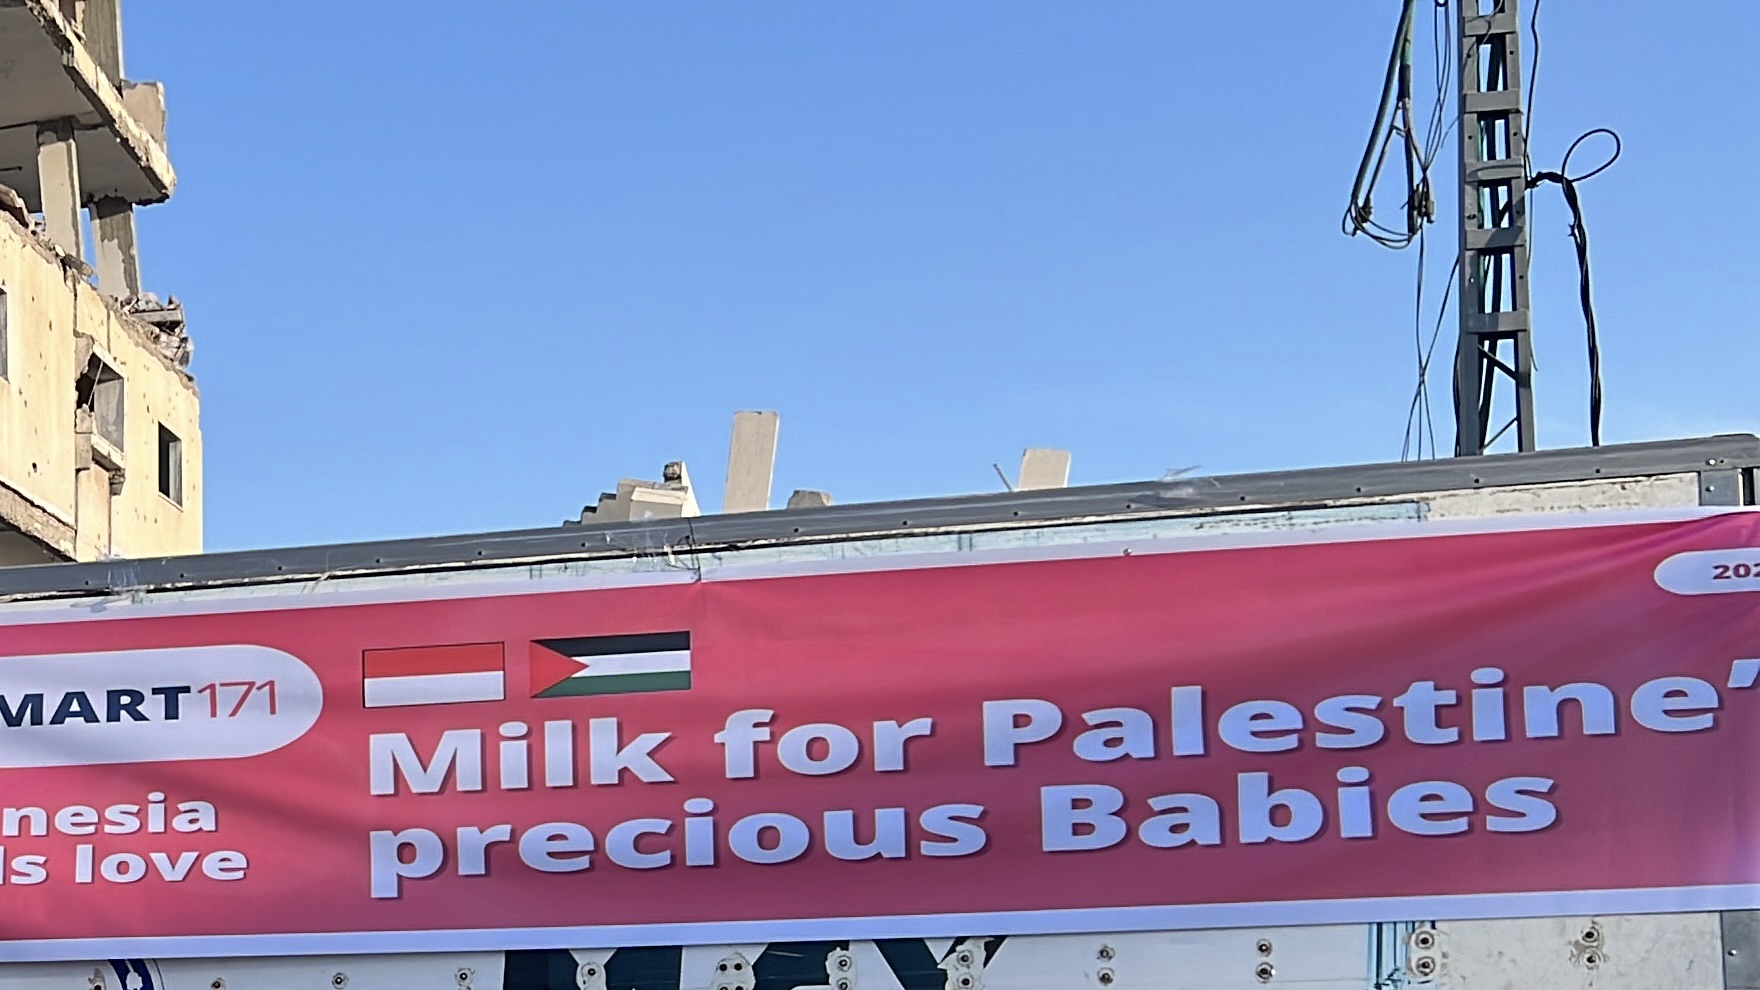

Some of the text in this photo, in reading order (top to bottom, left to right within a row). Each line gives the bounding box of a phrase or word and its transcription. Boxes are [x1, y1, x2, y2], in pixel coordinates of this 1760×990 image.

[369, 717, 675, 796] Milk
[714, 709, 933, 780] for
[74, 843, 249, 885] love
[370, 766, 1559, 899] precious Babies
